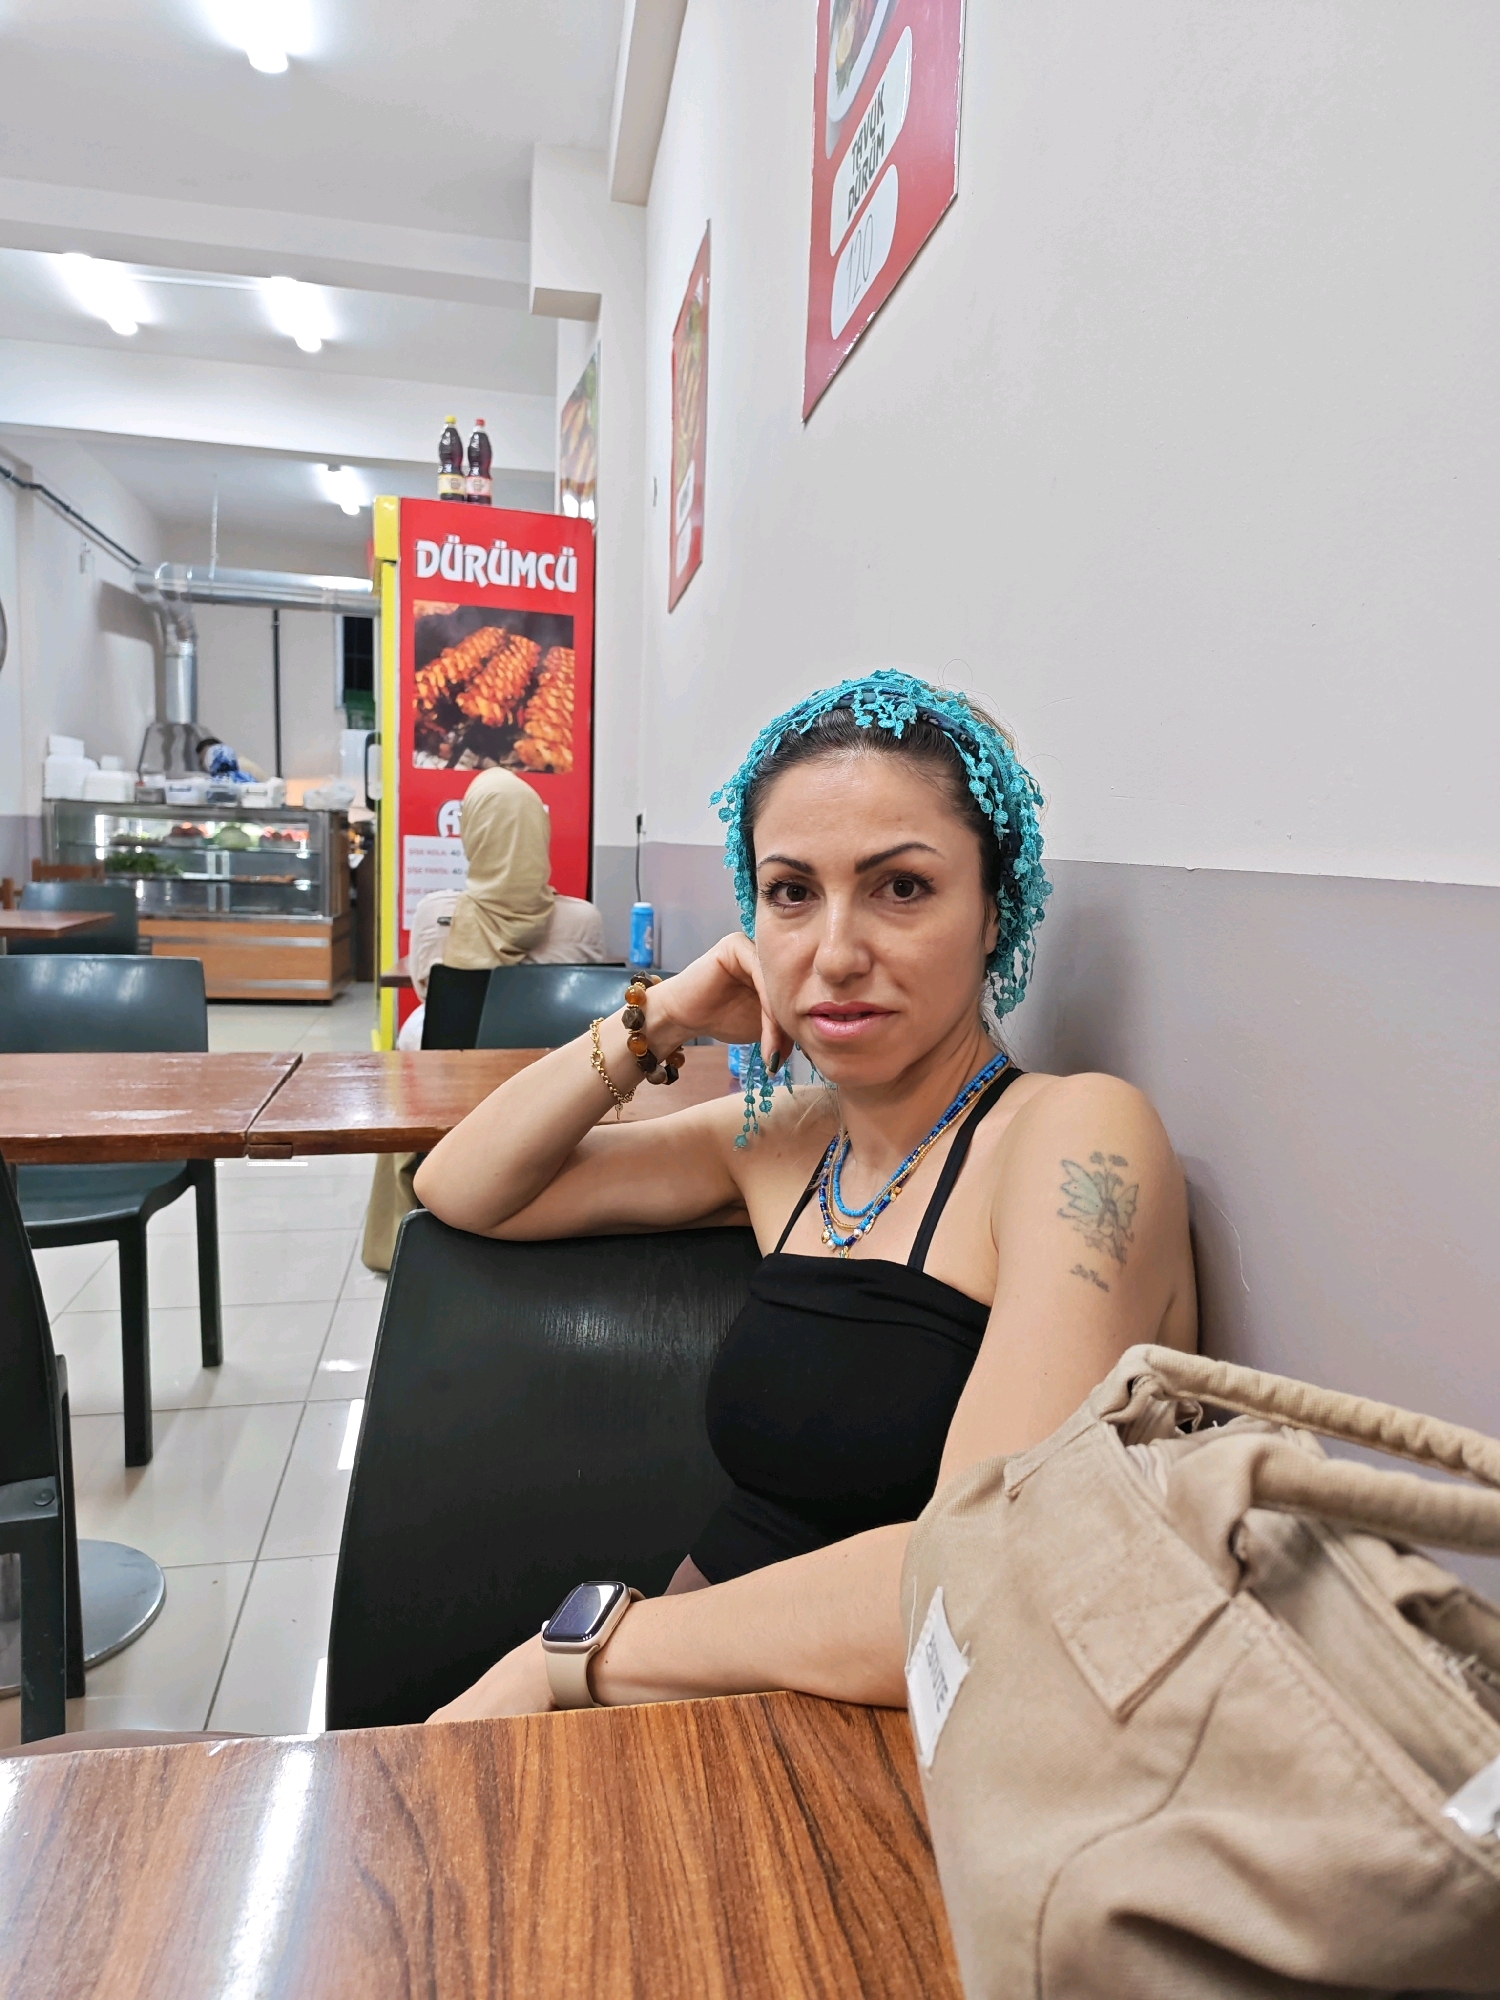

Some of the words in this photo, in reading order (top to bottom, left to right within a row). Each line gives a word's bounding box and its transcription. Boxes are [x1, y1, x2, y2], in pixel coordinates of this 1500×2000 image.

[847, 121, 886, 222] DÜRÜM
[851, 80, 885, 175] TAVUK
[846, 213, 874, 313] 120
[415, 534, 578, 593] DÜRÜMCÜ
